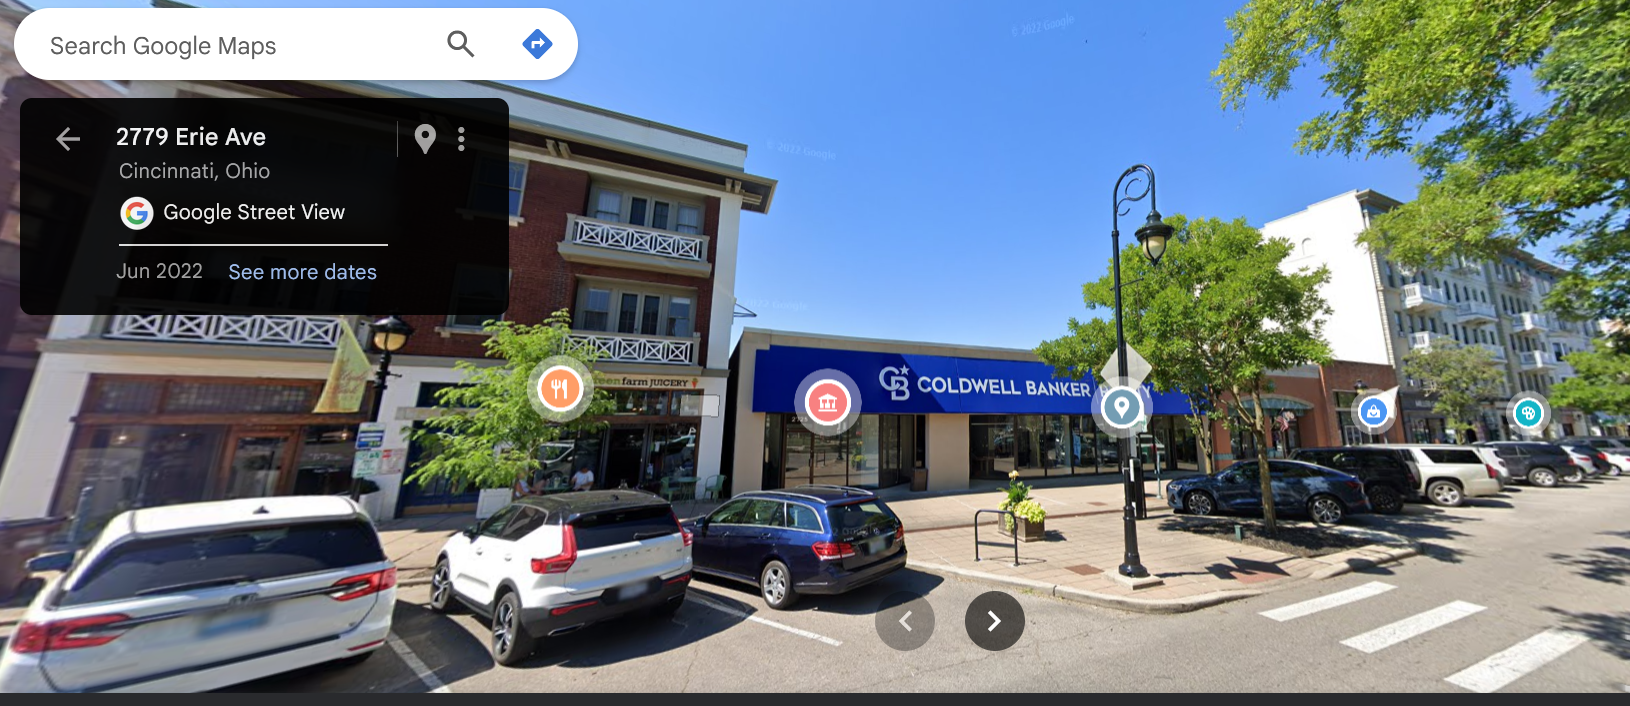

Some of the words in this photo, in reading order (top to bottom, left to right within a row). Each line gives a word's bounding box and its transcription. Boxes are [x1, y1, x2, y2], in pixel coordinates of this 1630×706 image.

[622, 377, 648, 386] farm
[649, 379, 688, 388] JUICERY
[917, 376, 1021, 395] COLDWELL
[1025, 380, 1092, 397] BANKER
